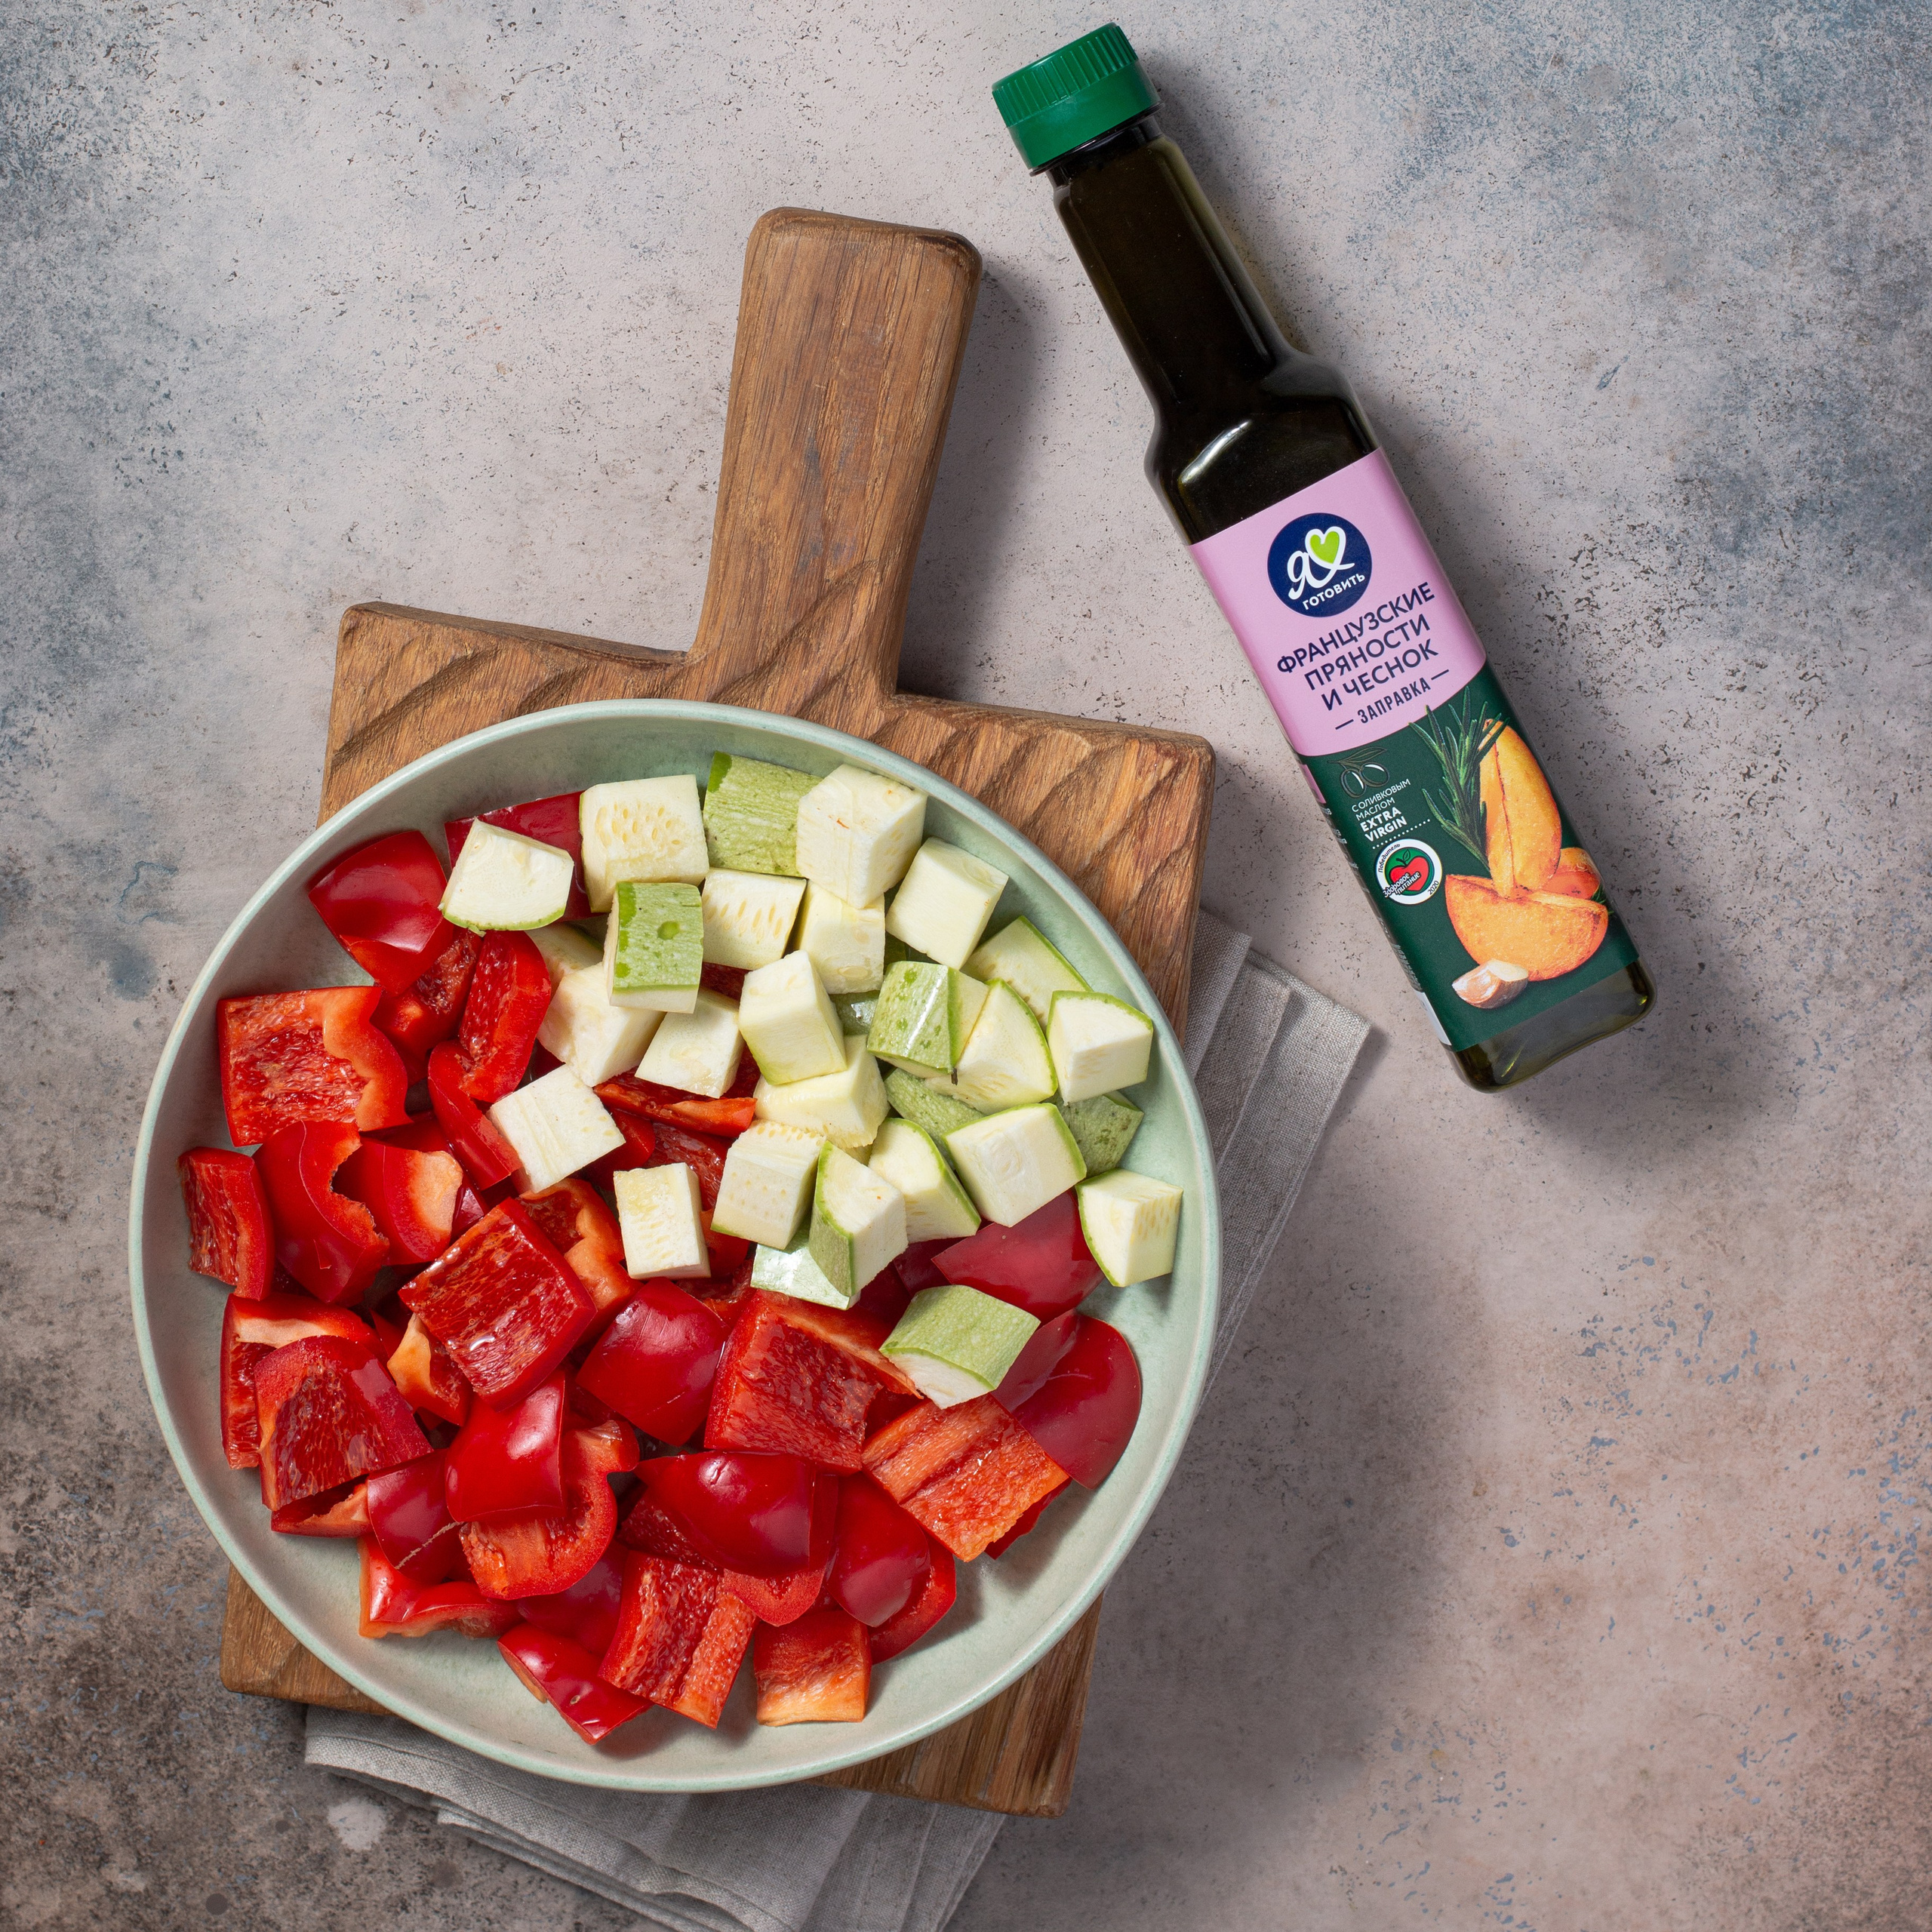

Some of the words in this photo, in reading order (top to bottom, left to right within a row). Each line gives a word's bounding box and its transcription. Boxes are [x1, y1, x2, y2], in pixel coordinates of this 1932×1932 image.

[1303, 573, 1365, 610] ГОТОВИТЬ
[1277, 582, 1435, 674] ФРАНЦУЗСКИЕ
[1304, 614, 1431, 691] ПРЯНОСТИ
[1321, 690, 1343, 711] И
[1343, 639, 1439, 696] ЧЕСНОК
[1358, 678, 1432, 724] ЗАПРАВКА
[1355, 797, 1395, 821] МАСЛОМ
[1360, 807, 1402, 832] EXTRA
[1364, 816, 1407, 842] VIRGIN
[1378, 844, 1401, 873] Победитель
[1383, 872, 1411, 898] Здоровое
[1395, 872, 1421, 895] питание
[1428, 880, 1439, 895] 2020
